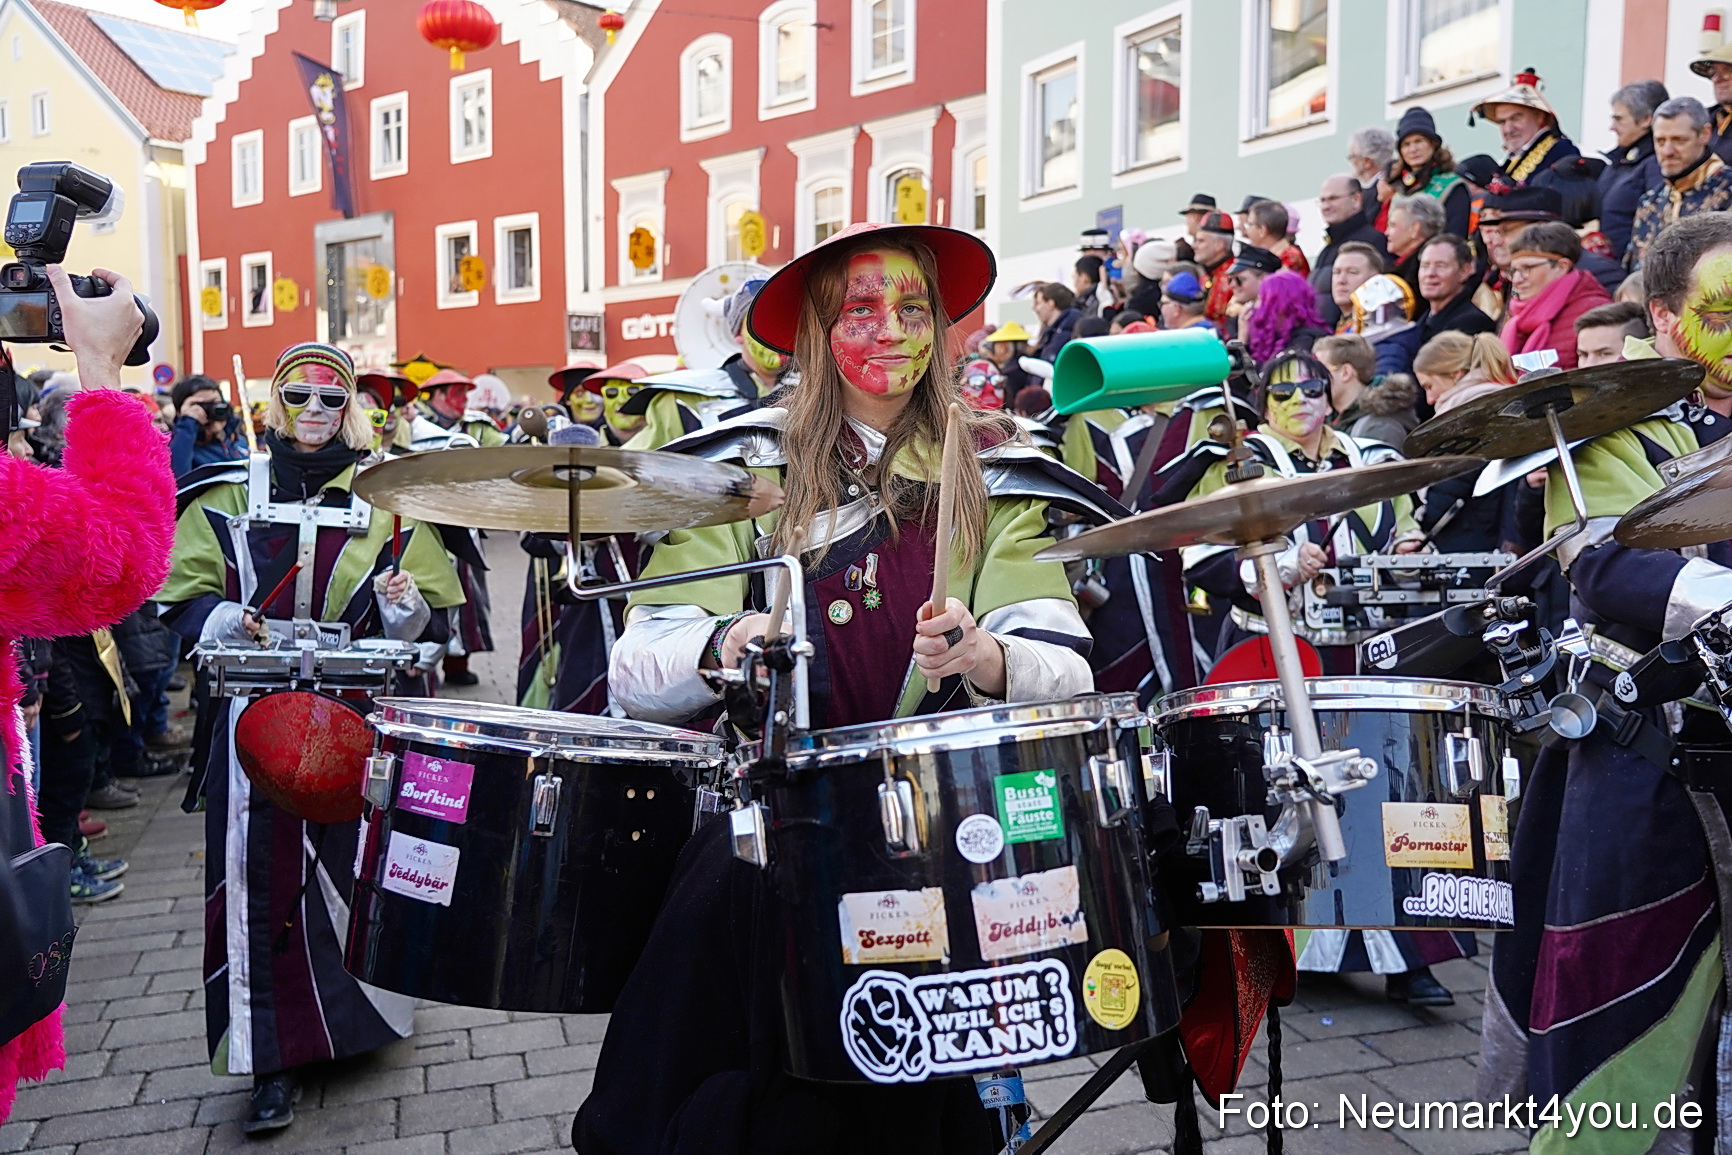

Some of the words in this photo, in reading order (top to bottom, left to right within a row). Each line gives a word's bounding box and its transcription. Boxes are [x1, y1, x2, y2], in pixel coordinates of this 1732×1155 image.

[418, 770, 450, 783] FICKEN
[400, 781, 466, 809] Dorfkind
[1004, 786, 1049, 800] Bussi
[1007, 810, 1055, 826] Fäuste
[1390, 832, 1468, 853] Pornostar
[405, 853, 433, 866] FICKEN
[388, 862, 449, 889] Teddybär
[1009, 896, 1049, 909] FICKEN
[1459, 880, 1497, 917] EINER
[870, 911, 910, 920] FICKEN
[858, 929, 933, 949] Sexgott
[931, 1009, 995, 1032] WEIL
